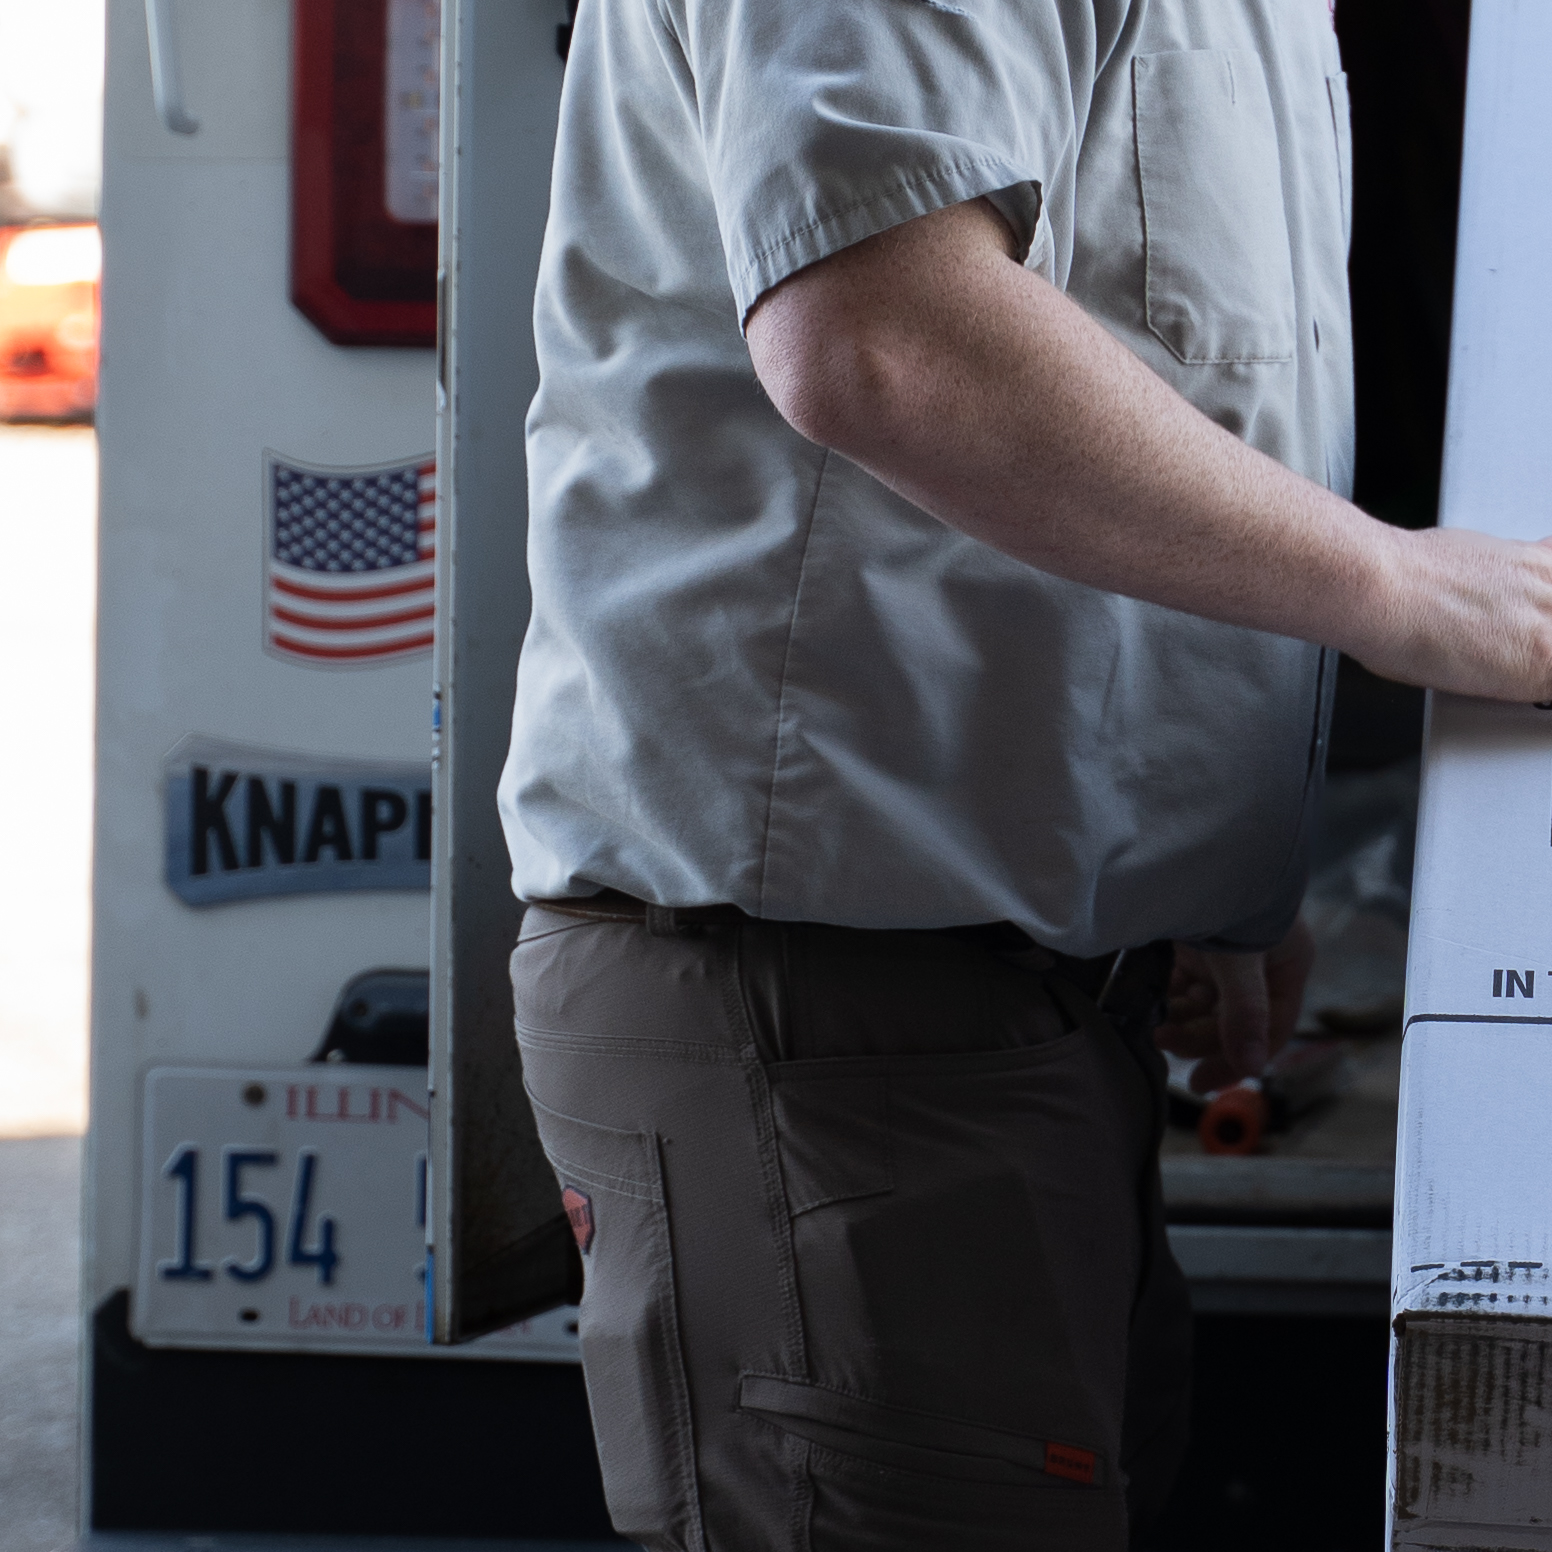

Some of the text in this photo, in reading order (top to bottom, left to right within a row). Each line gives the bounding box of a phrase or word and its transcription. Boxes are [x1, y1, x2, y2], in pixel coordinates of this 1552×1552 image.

[190, 765, 431, 878] KNAP
[1492, 969, 1535, 999] IN
[161, 1142, 338, 1285] 154
